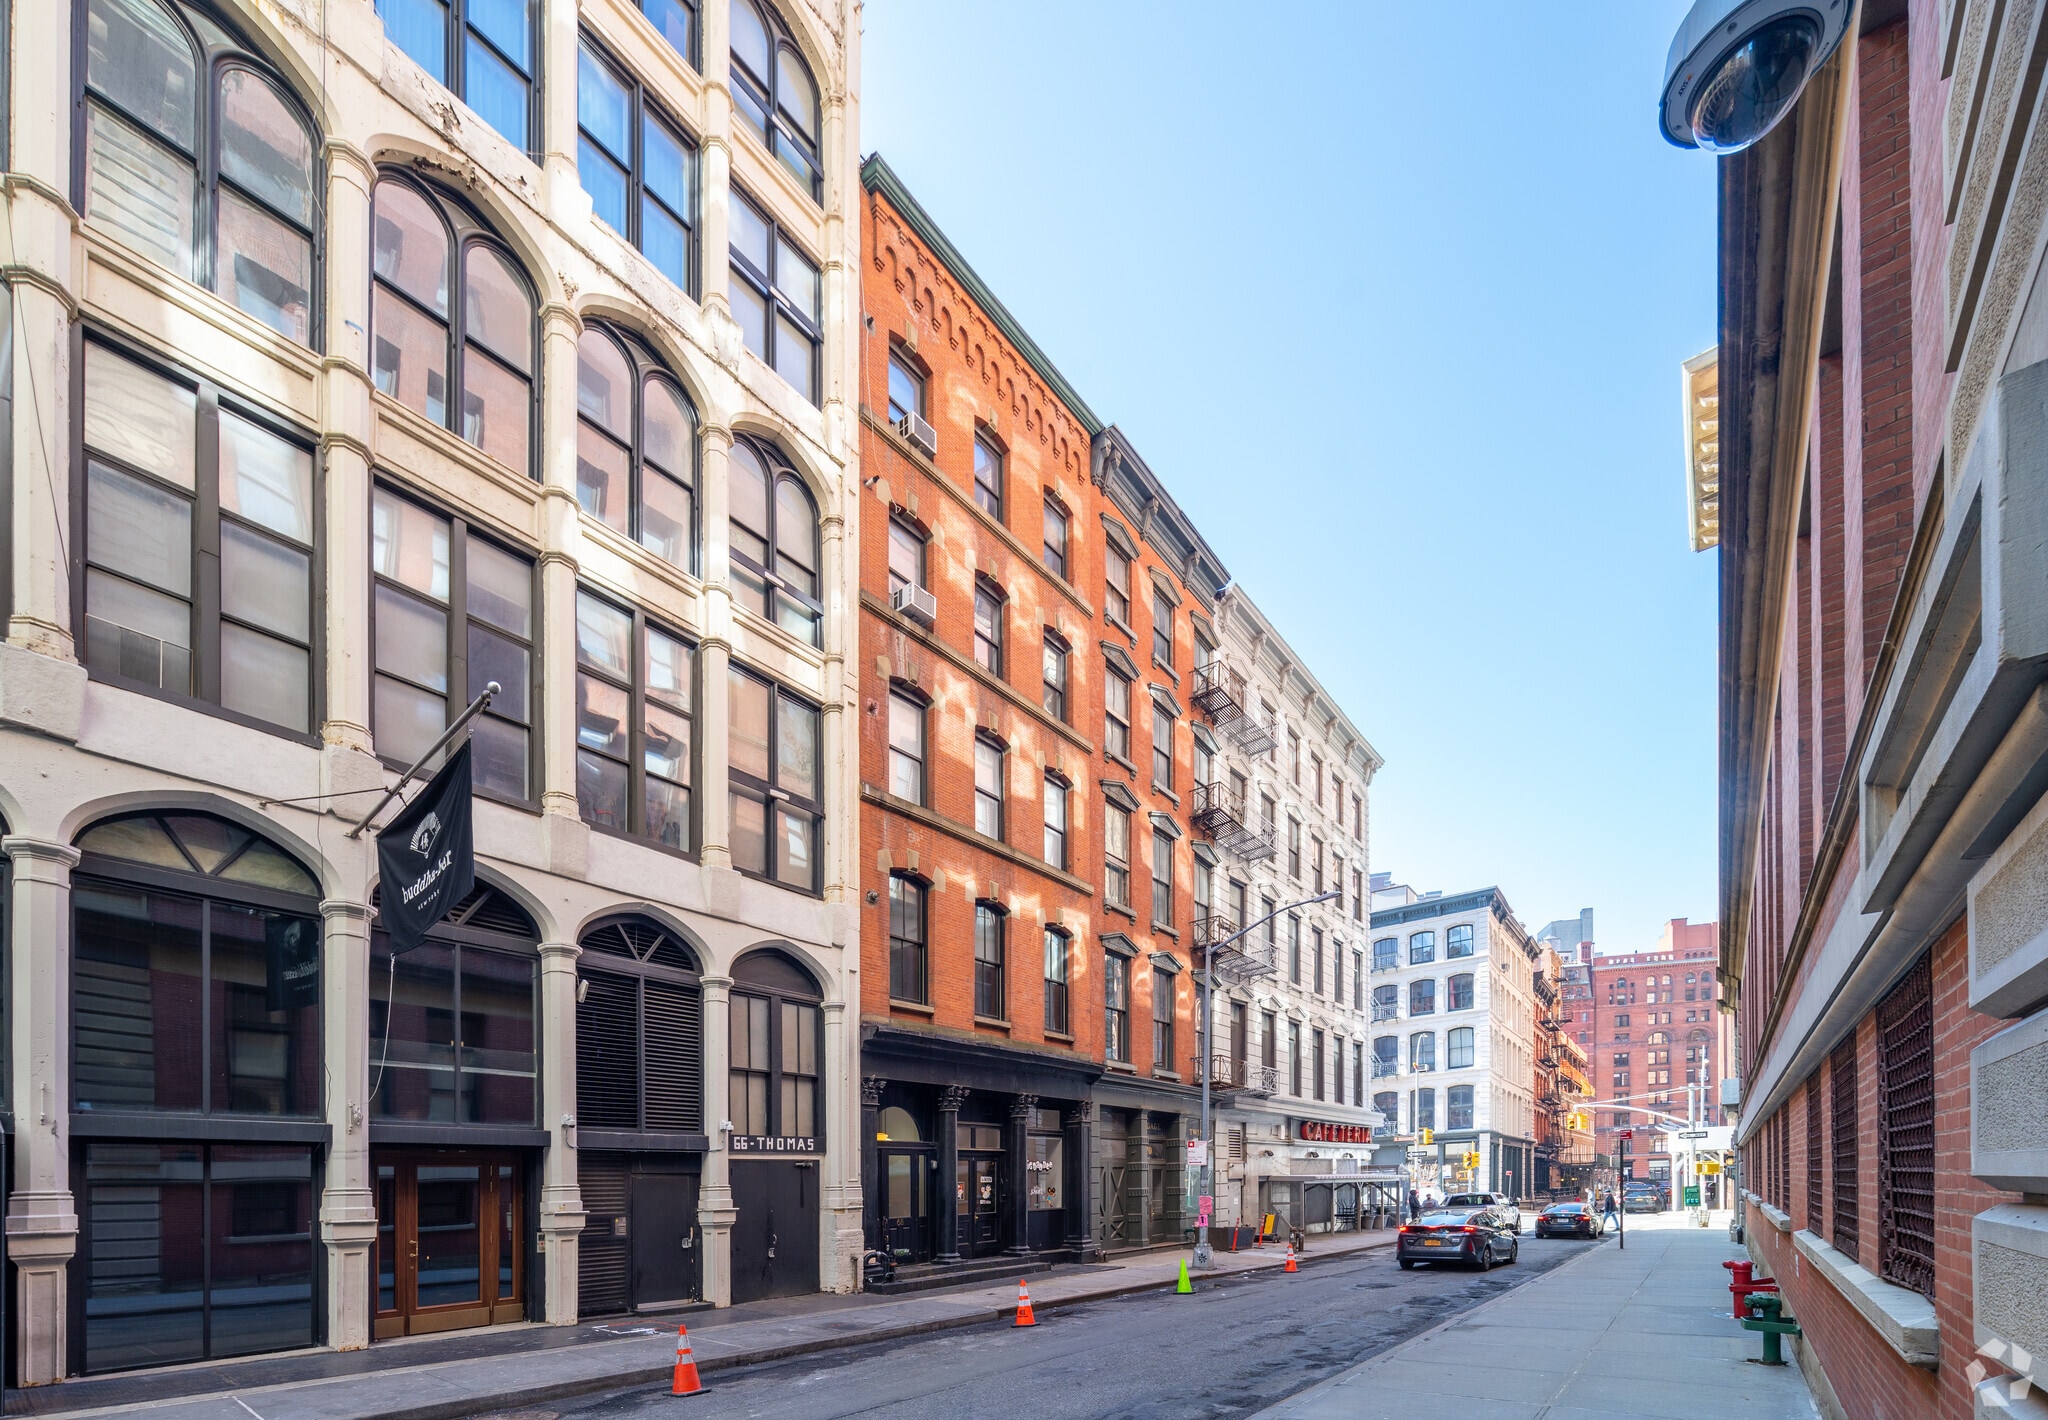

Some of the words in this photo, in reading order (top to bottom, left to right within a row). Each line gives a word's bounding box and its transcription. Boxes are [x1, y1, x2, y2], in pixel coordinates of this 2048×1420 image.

[1678, 80, 1689, 96] AXIS
[1305, 1120, 1373, 1143] CAFETERIA
[733, 1136, 814, 1151] 66-THOMAS
